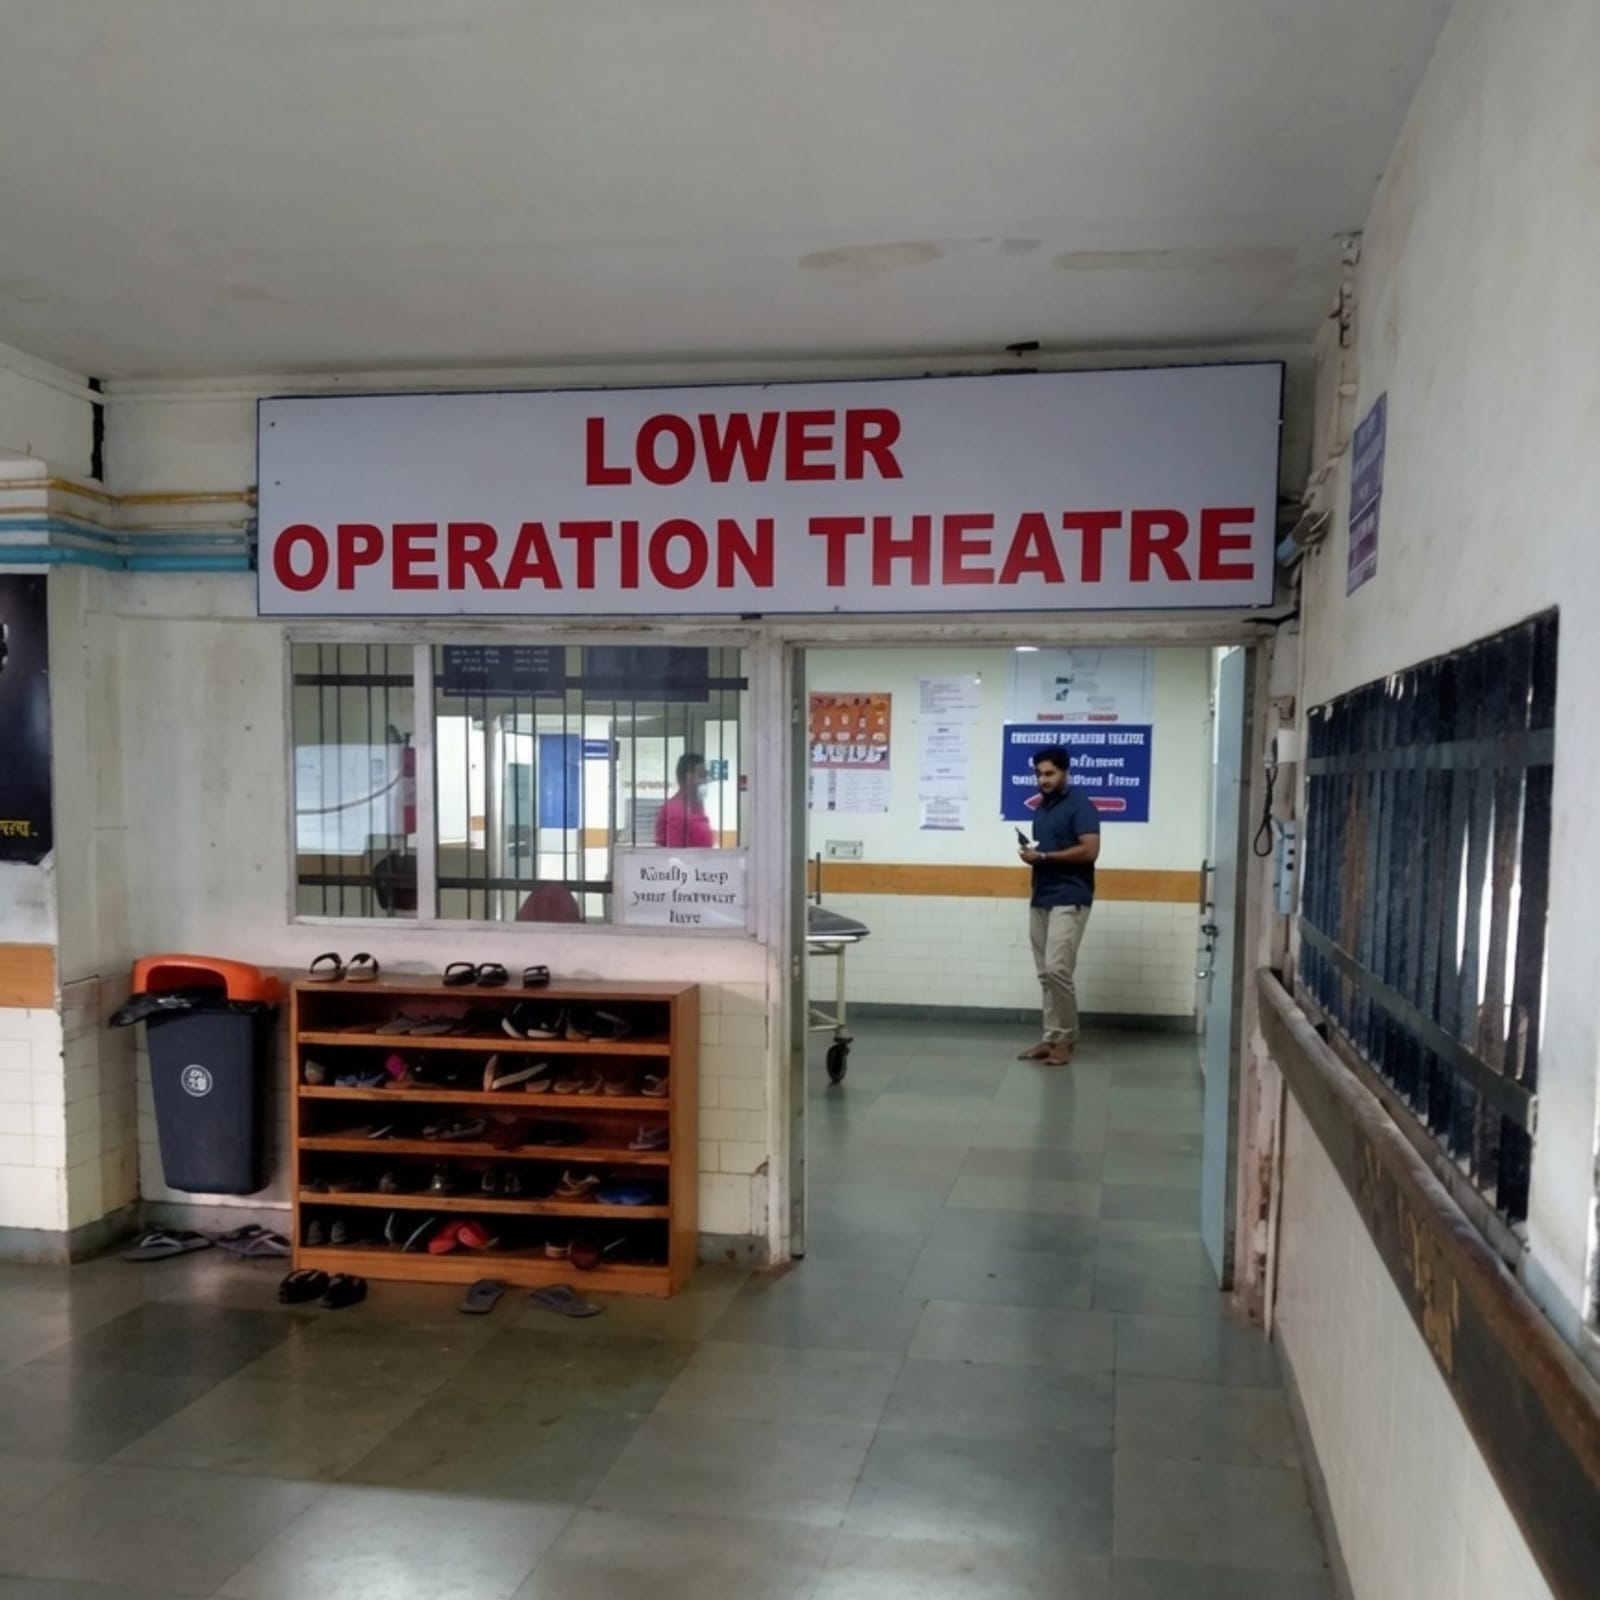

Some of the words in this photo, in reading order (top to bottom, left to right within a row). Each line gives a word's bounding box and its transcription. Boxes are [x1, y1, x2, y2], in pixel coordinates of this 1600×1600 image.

[586, 408, 903, 486] LOWER
[273, 518, 775, 592] OPERATION
[808, 507, 1254, 586] THEATRE
